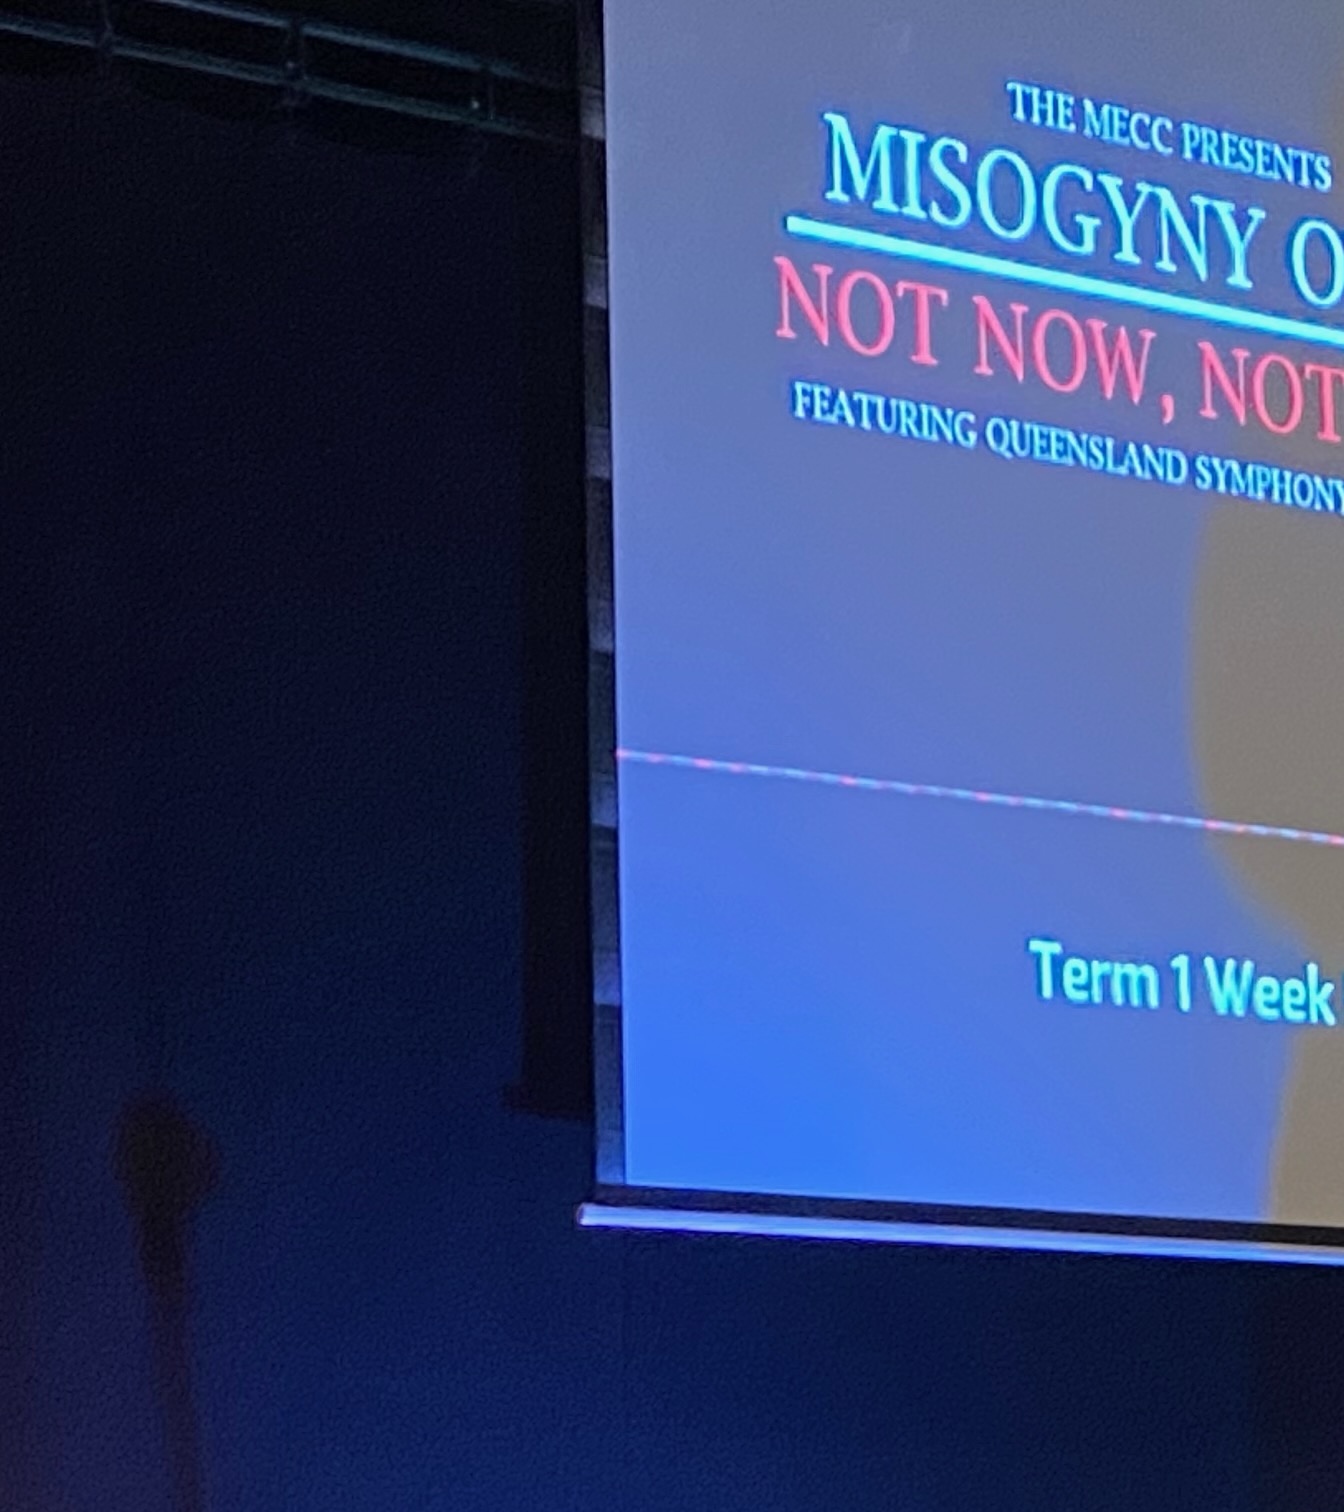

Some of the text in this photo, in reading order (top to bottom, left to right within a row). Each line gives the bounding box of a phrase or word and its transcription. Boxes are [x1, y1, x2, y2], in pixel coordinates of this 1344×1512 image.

[1006, 80, 1334, 192] THE MECC PRESENTS
[822, 111, 1267, 290] MISOGYNY
[773, 256, 949, 366] NOT
[792, 380, 977, 449] FEATURING
[984, 420, 1188, 486] QUEENSLAND
[1027, 938, 1161, 1010] Term
[1169, 952, 1192, 1013] 1
[1202, 955, 1337, 1027] Week
